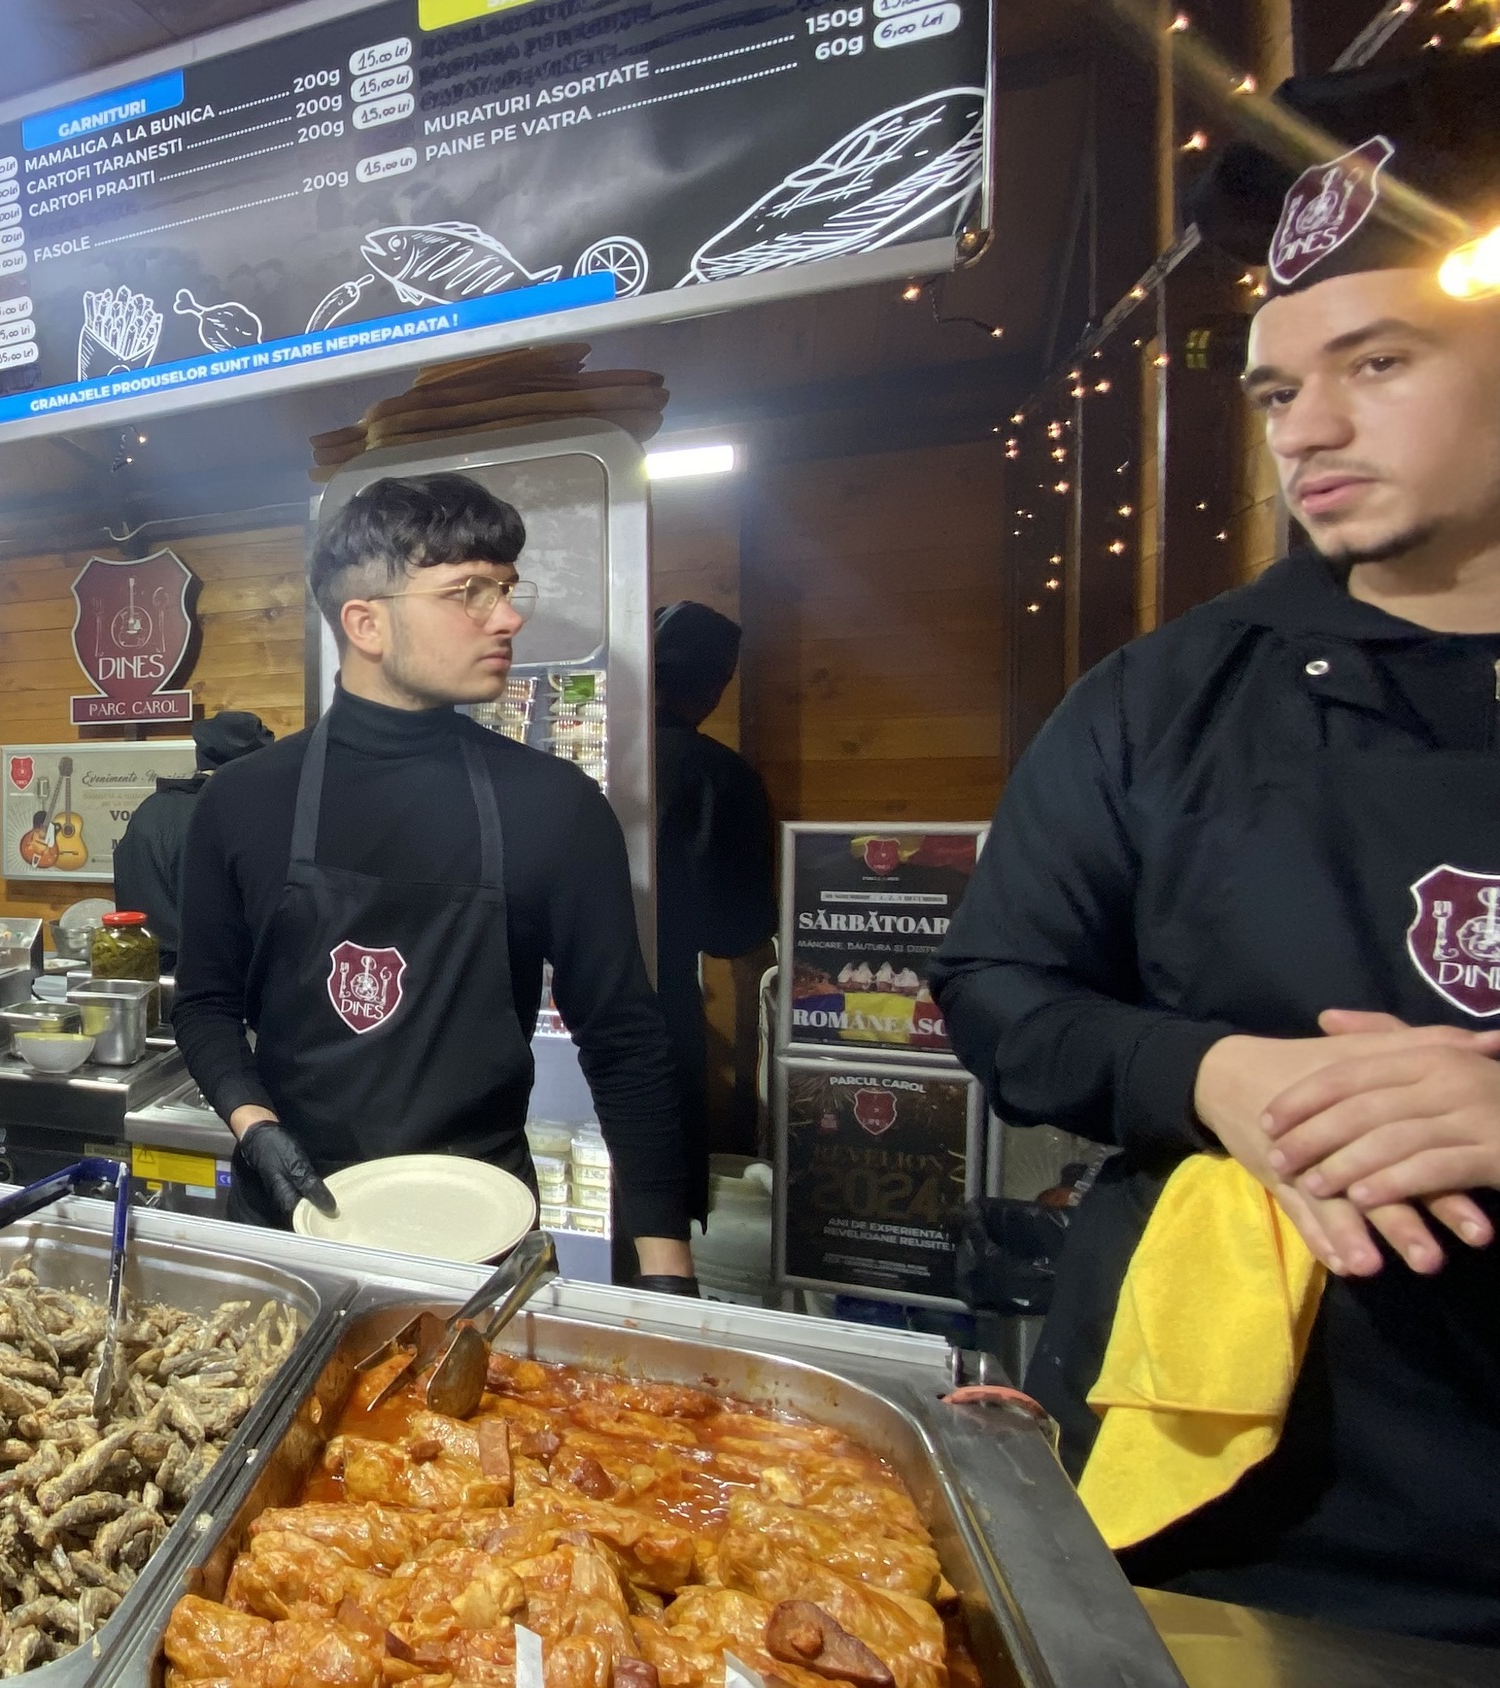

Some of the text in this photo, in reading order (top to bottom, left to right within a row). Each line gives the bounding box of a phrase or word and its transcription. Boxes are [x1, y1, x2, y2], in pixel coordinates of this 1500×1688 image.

[424, 7, 864, 136] MURATURI ASORTATE 150g
[426, 35, 864, 162] PAINE PE VATRA 60g
[24, 69, 340, 173] MAMALIGA A LA BUNICA 200g
[58, 99, 147, 138] GARNITURI
[26, 94, 342, 195] CARTOFI TARANESTI 200g
[28, 120, 344, 217] CARTOFI PRAJITI 200g
[33, 170, 349, 263] FASOLE 200g
[1276, 226, 1340, 267] DINES
[30, 385, 111, 412] GRAMAJELE
[112, 366, 208, 395] PRODUSELOR
[211, 356, 251, 376] SUNT
[252, 352, 269, 368] IN
[272, 341, 323, 363] STARE
[326, 315, 450, 352] NEPREPARATA
[99, 654, 165, 680] DINES
[89, 700, 179, 716] PARC CAROL
[110, 810, 132, 821] VO
[799, 908, 950, 935] SĂRBĂTOAR
[1439, 961, 1500, 991] DIN
[341, 998, 385, 1019] DINES
[793, 1008, 949, 1037] ROMÂNEASC
[829, 1076, 927, 1094] PARCUL CAROL
